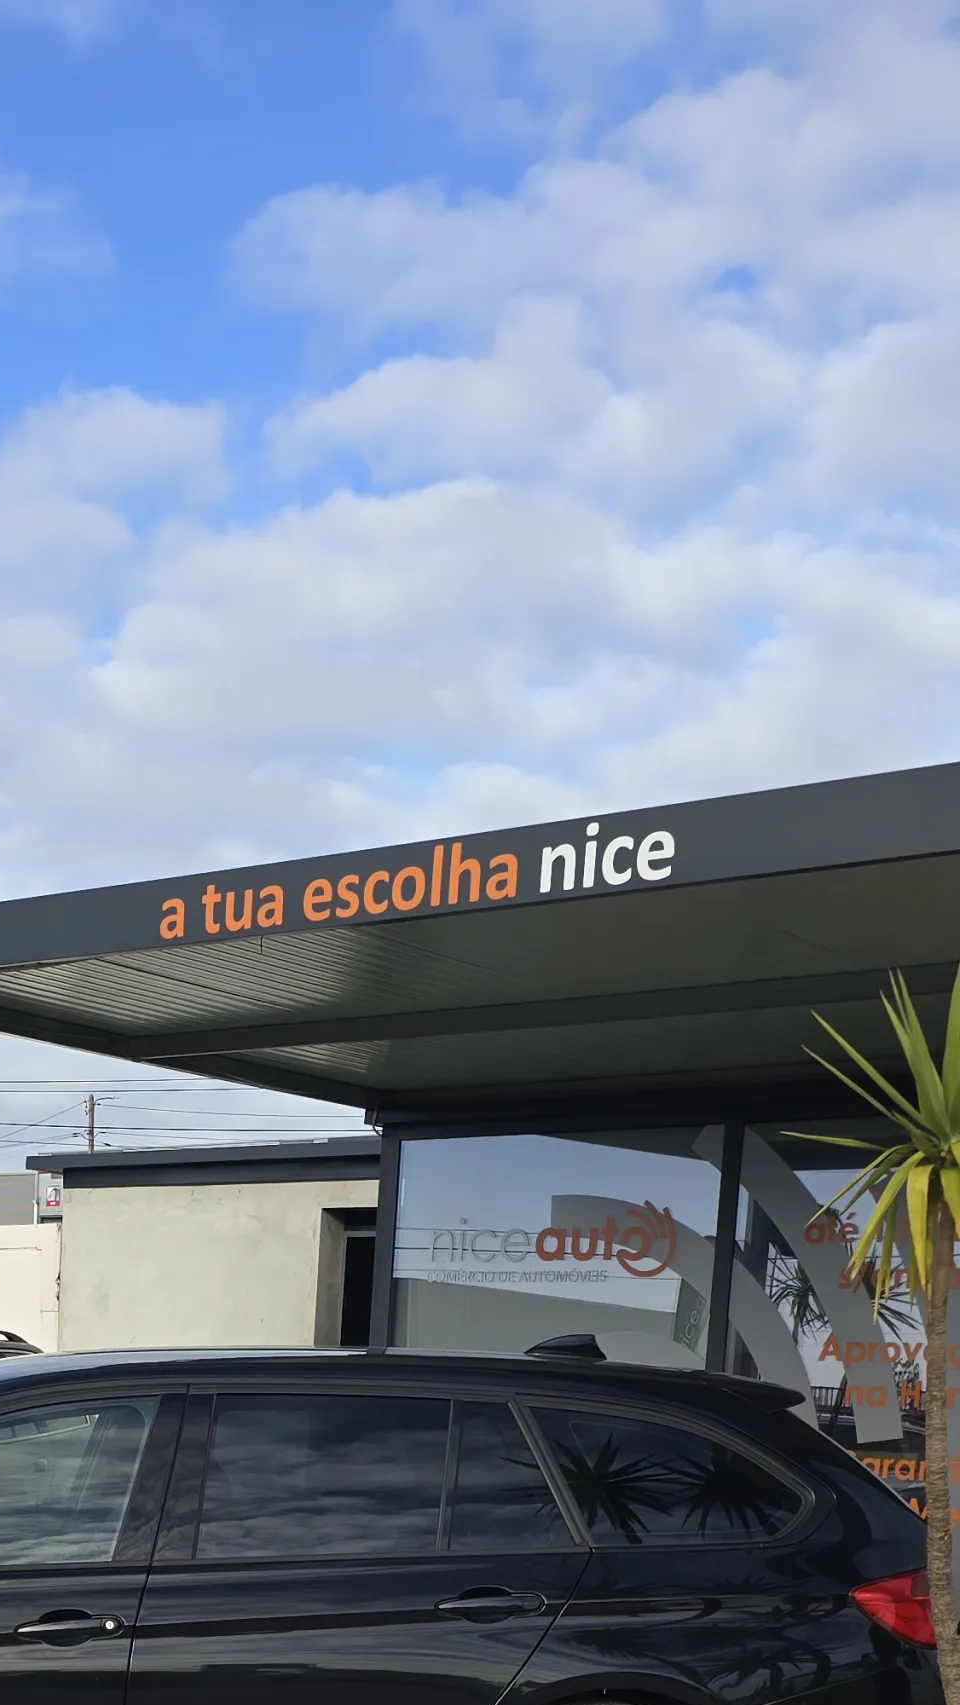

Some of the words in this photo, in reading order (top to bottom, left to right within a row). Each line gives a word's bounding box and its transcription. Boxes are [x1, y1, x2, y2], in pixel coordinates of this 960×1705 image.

[159, 896, 185, 940] a
[202, 883, 284, 935] tua
[302, 842, 519, 922] escolha
[538, 822, 677, 895] nice
[498, 1270, 517, 1283] DE
[845, 1384, 887, 1407] na
